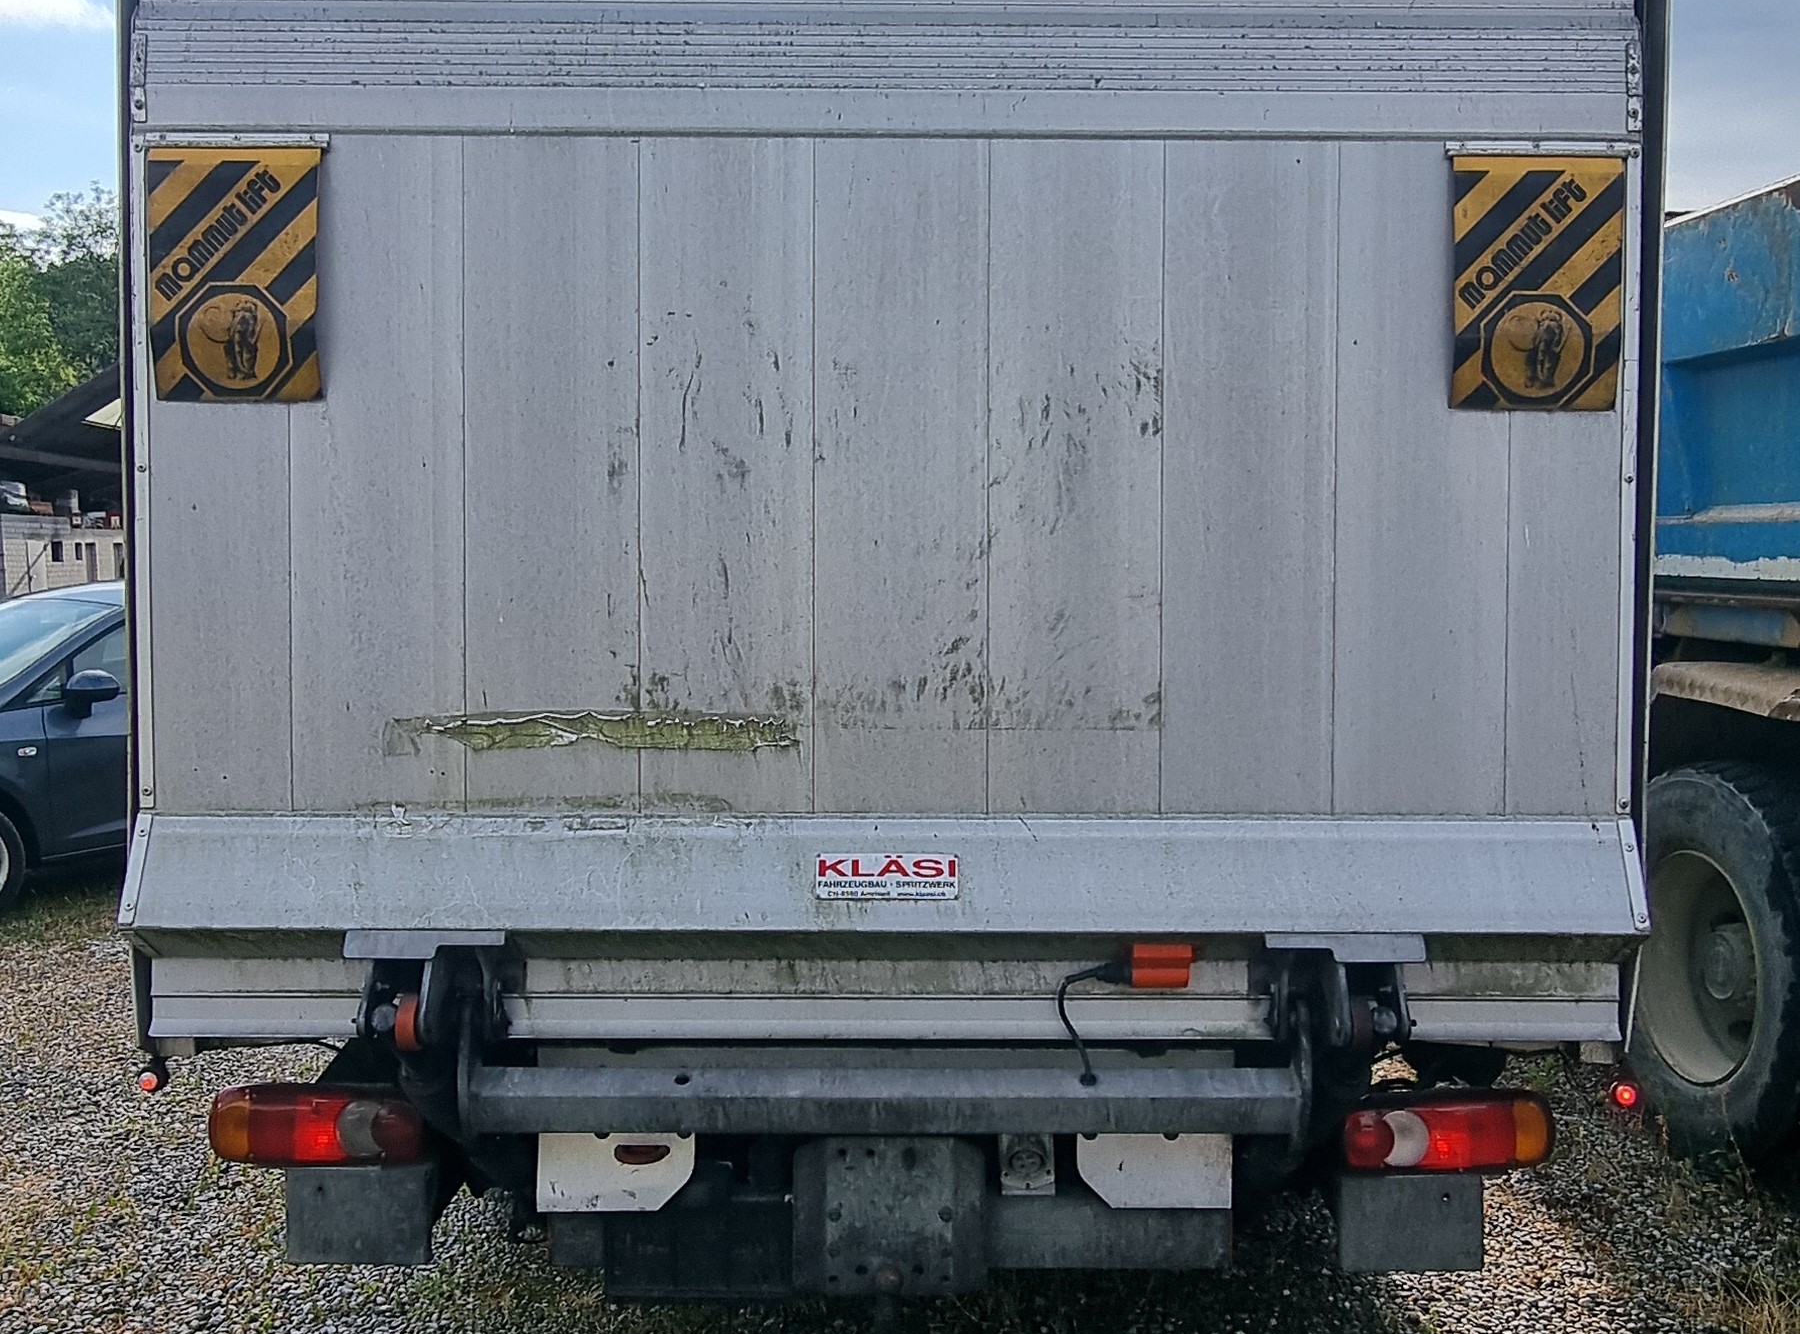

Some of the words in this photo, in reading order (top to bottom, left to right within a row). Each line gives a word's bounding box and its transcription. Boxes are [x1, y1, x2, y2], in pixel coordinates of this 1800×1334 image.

[235, 169, 282, 216] lift
[1540, 178, 1587, 225] lift
[818, 855, 957, 878] KLÄSI
[818, 880, 888, 888] FAHRZEUGBAU
[896, 880, 956, 888] SPRITZWERK
